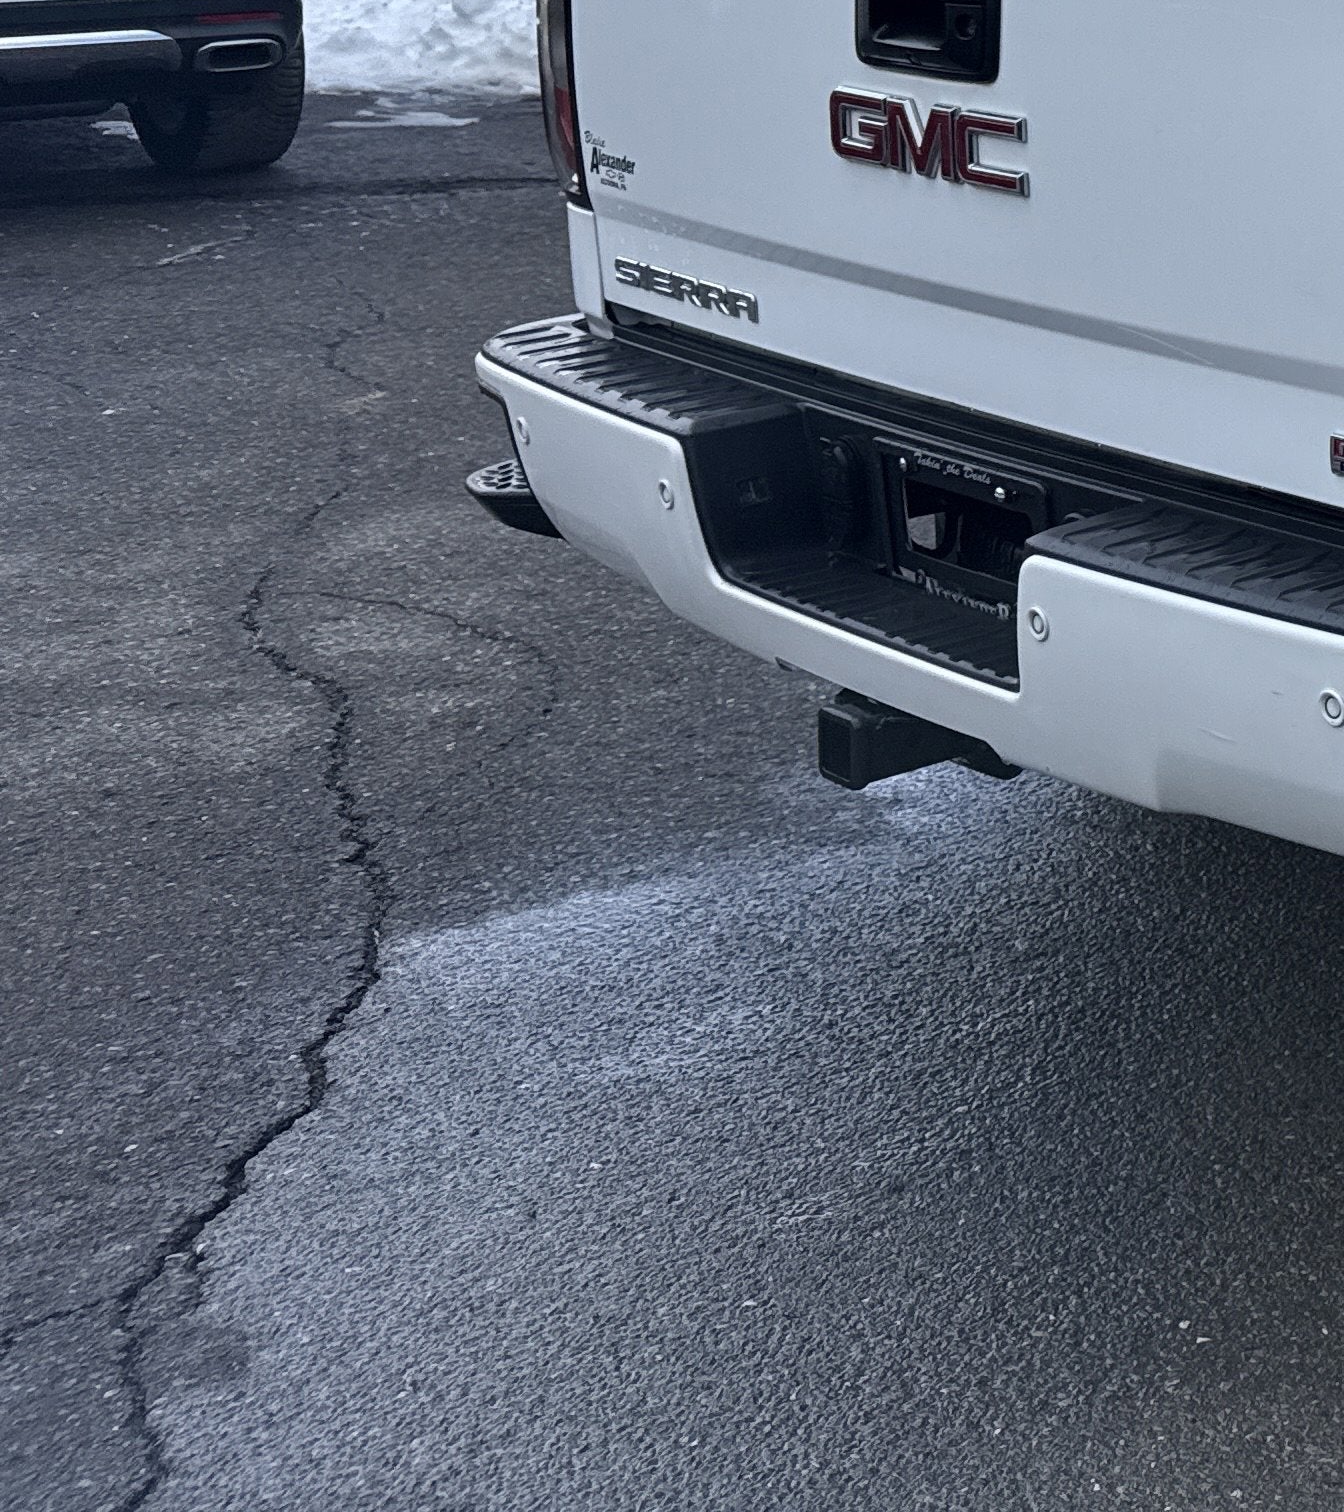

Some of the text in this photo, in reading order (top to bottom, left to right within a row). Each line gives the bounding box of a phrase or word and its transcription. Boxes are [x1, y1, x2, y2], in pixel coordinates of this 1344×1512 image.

[590, 146, 636, 175] Alexander
[829, 85, 1031, 198] GMC
[614, 255, 758, 324] SIERRA
[943, 463, 961, 476] the
